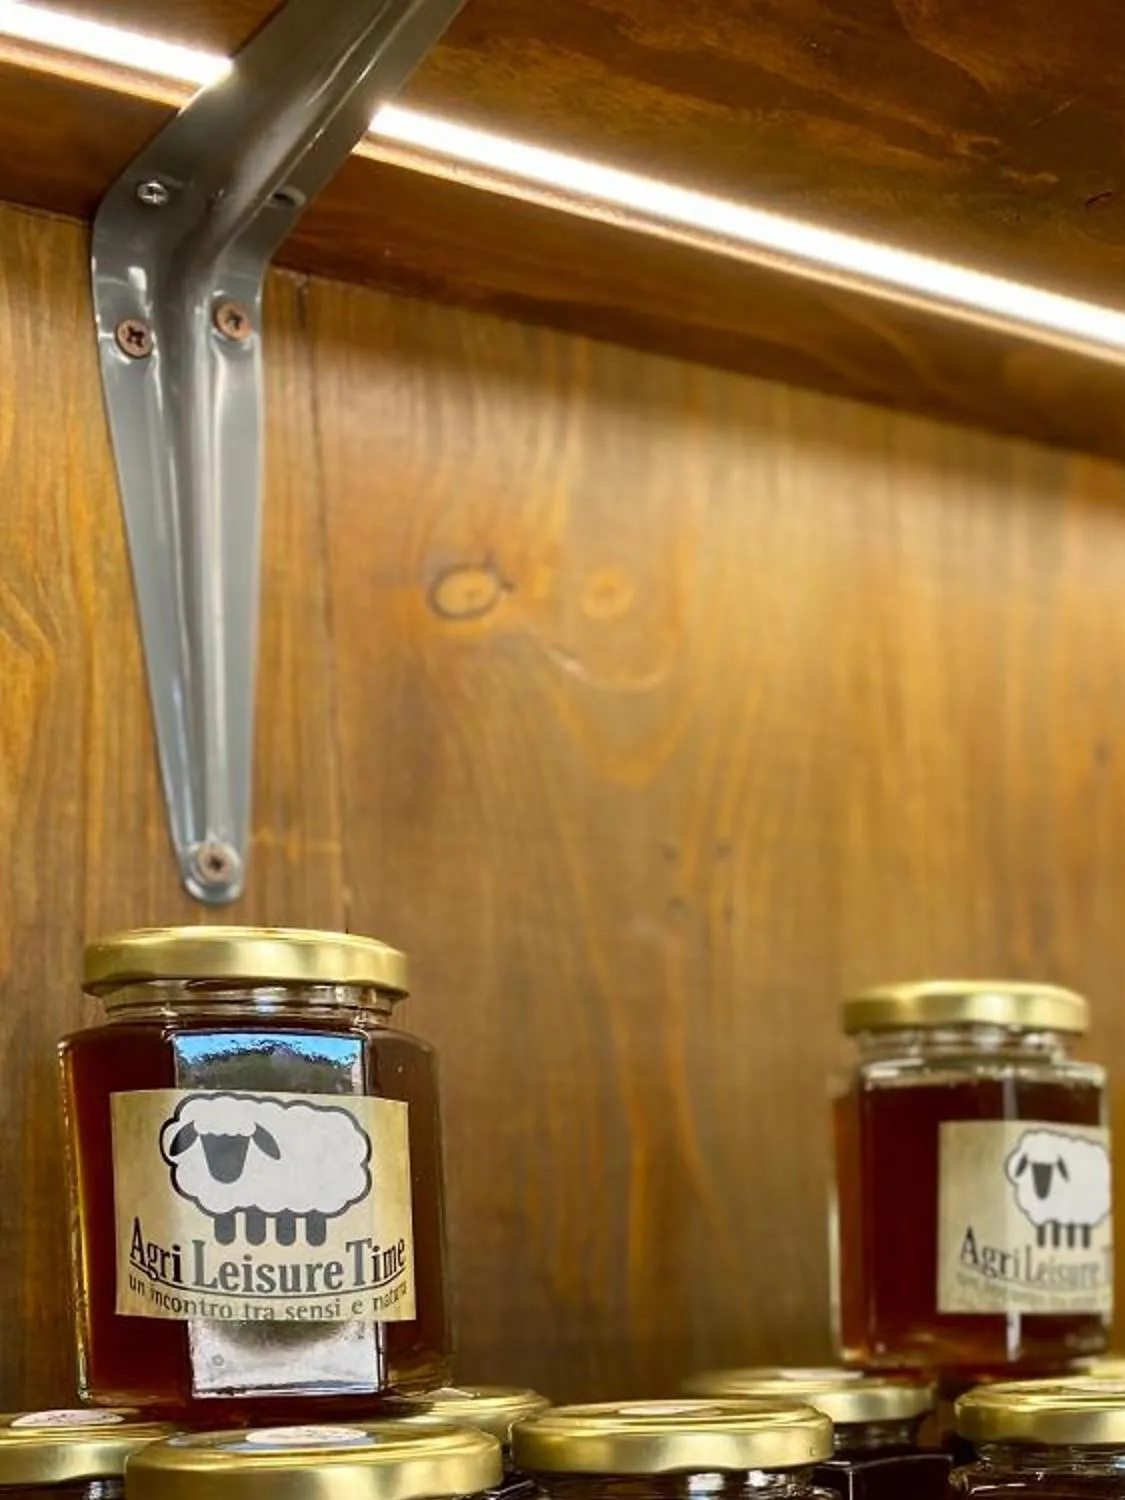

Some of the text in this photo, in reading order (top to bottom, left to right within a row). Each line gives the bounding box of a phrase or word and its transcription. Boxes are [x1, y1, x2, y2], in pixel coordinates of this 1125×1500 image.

[129, 1215, 405, 1292] Agri Leisure Time
[128, 1273, 145, 1296] un
[149, 1283, 233, 1319] incontro
[243, 1303, 275, 1320] tra
[284, 1297, 341, 1320] sensi
[351, 1299, 364, 1315] e
